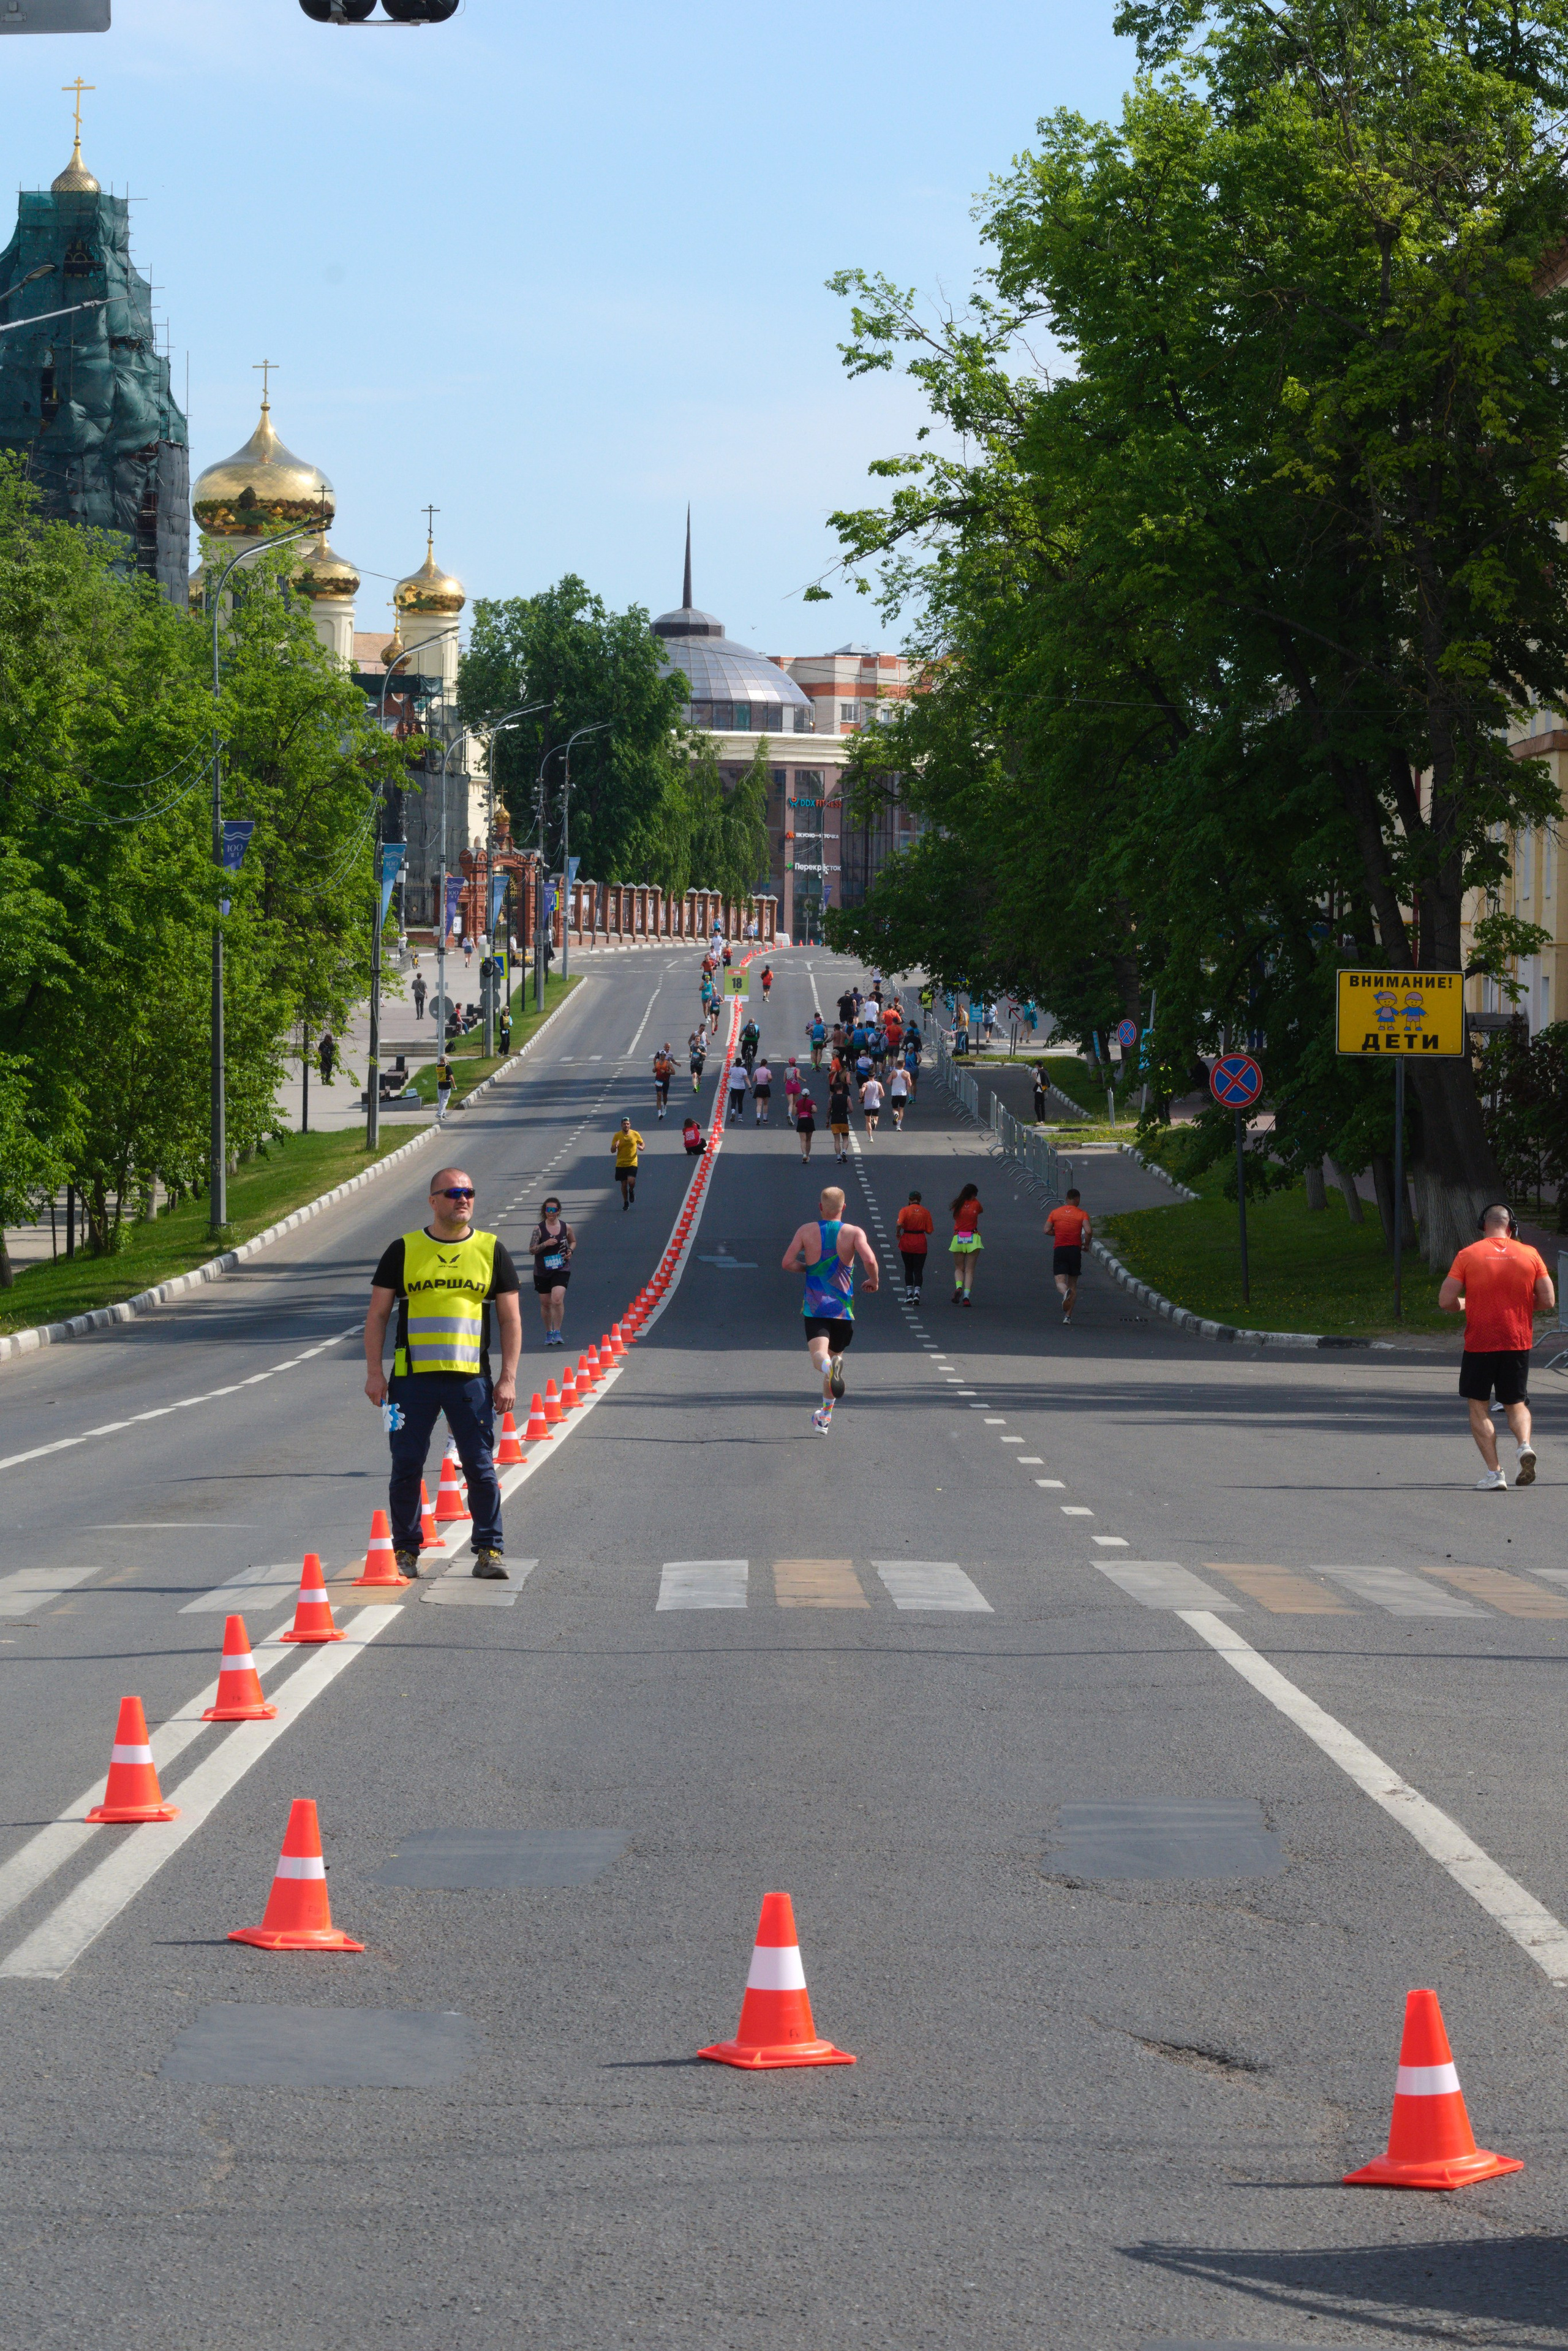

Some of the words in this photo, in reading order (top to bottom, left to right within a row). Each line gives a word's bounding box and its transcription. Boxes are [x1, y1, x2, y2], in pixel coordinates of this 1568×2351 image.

[732, 977, 742, 989] 18
[1349, 975, 1453, 989] ВНИМАНИЕ!
[1362, 1033, 1439, 1051] ДЕТИ
[407, 1278, 486, 1294] МАРШАЛ
